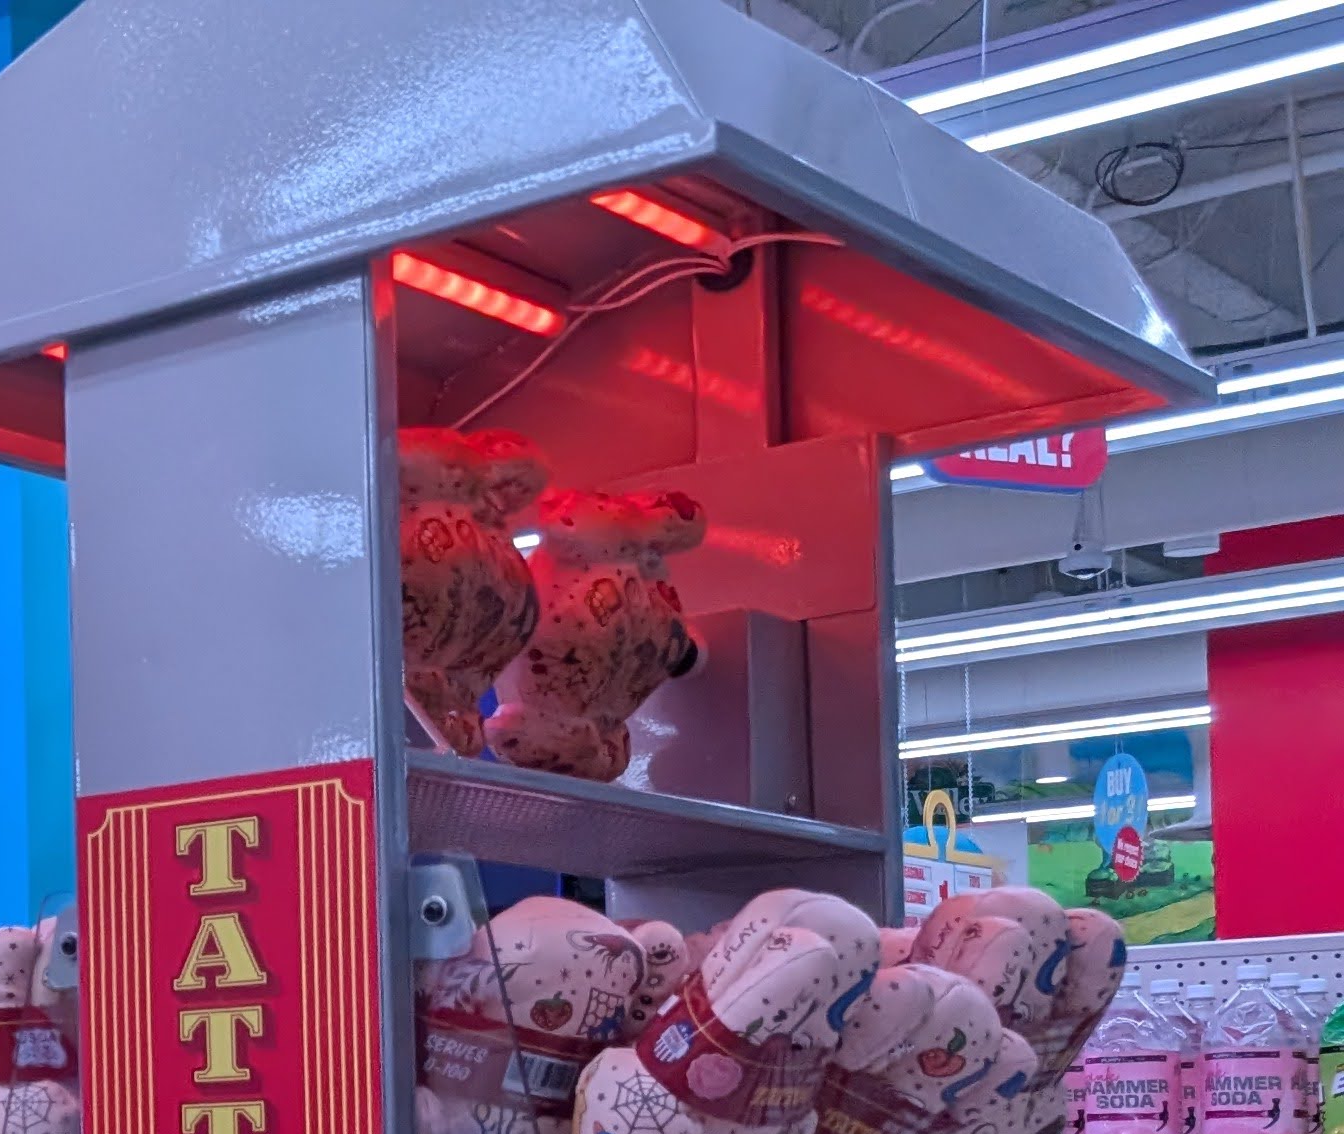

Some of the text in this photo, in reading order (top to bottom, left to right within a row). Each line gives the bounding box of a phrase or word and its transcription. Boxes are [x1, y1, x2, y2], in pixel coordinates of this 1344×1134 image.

[1107, 768, 1131, 796] BUY
[1096, 1094, 1155, 1109] SODA
[1211, 1091, 1262, 1106] SODA
